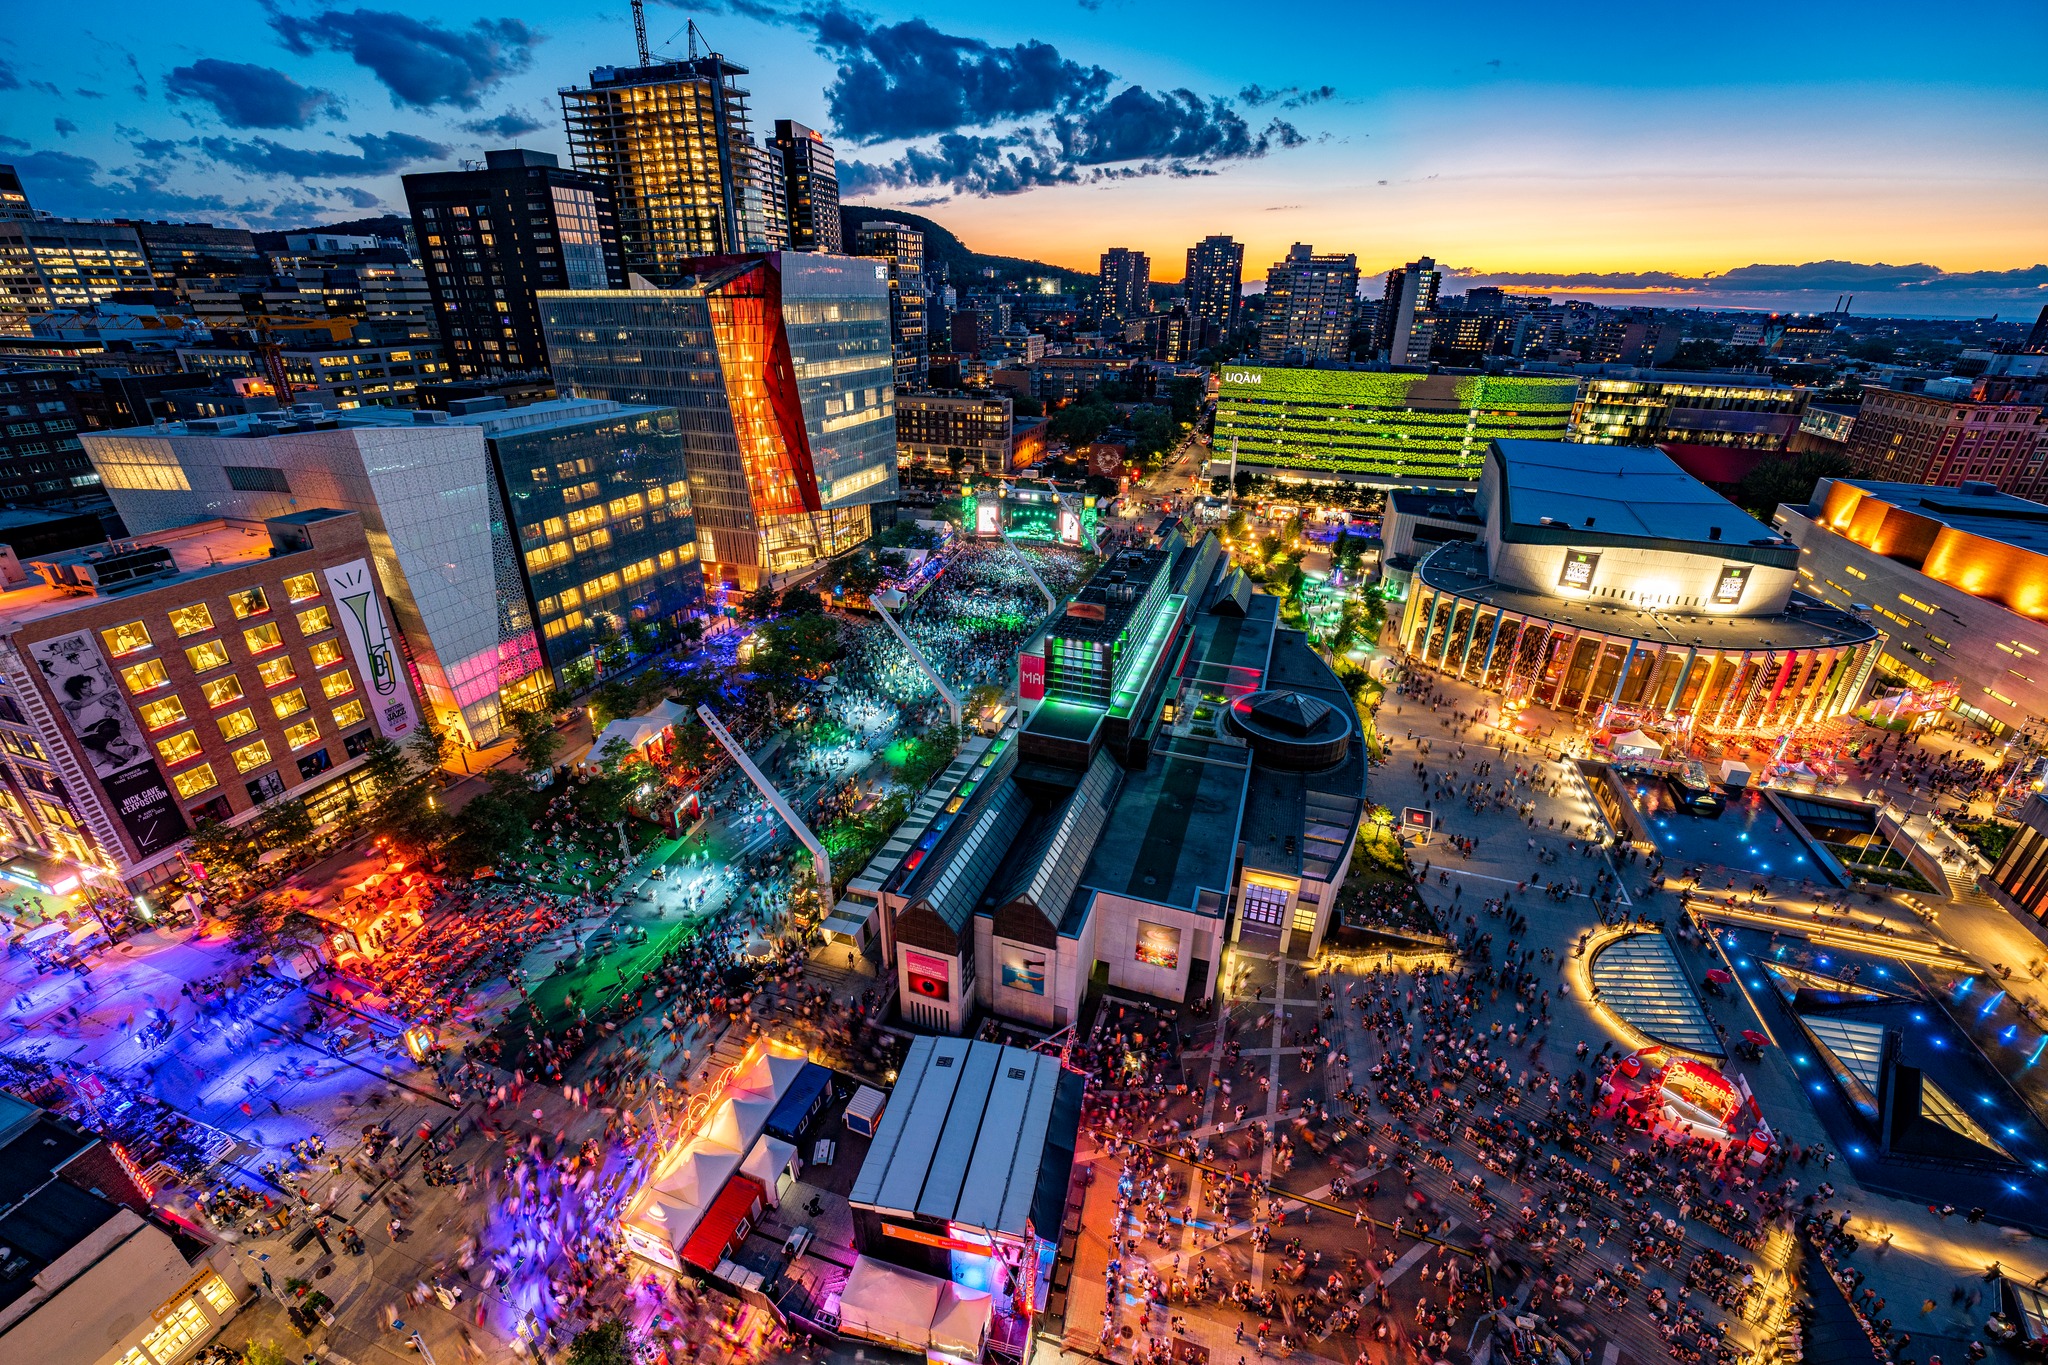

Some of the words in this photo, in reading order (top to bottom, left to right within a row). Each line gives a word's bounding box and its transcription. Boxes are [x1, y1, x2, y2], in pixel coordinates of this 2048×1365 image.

[387, 707, 406, 721] JAZZ
[121, 790, 168, 815] L'EXPOSITION
[122, 795, 141, 806] NICK
[141, 786, 160, 798] CAVE
[66, 802, 80, 821] STUDIO
[1139, 940, 1156, 949] MIKA
[1688, 1071, 1734, 1101] ROGERS
